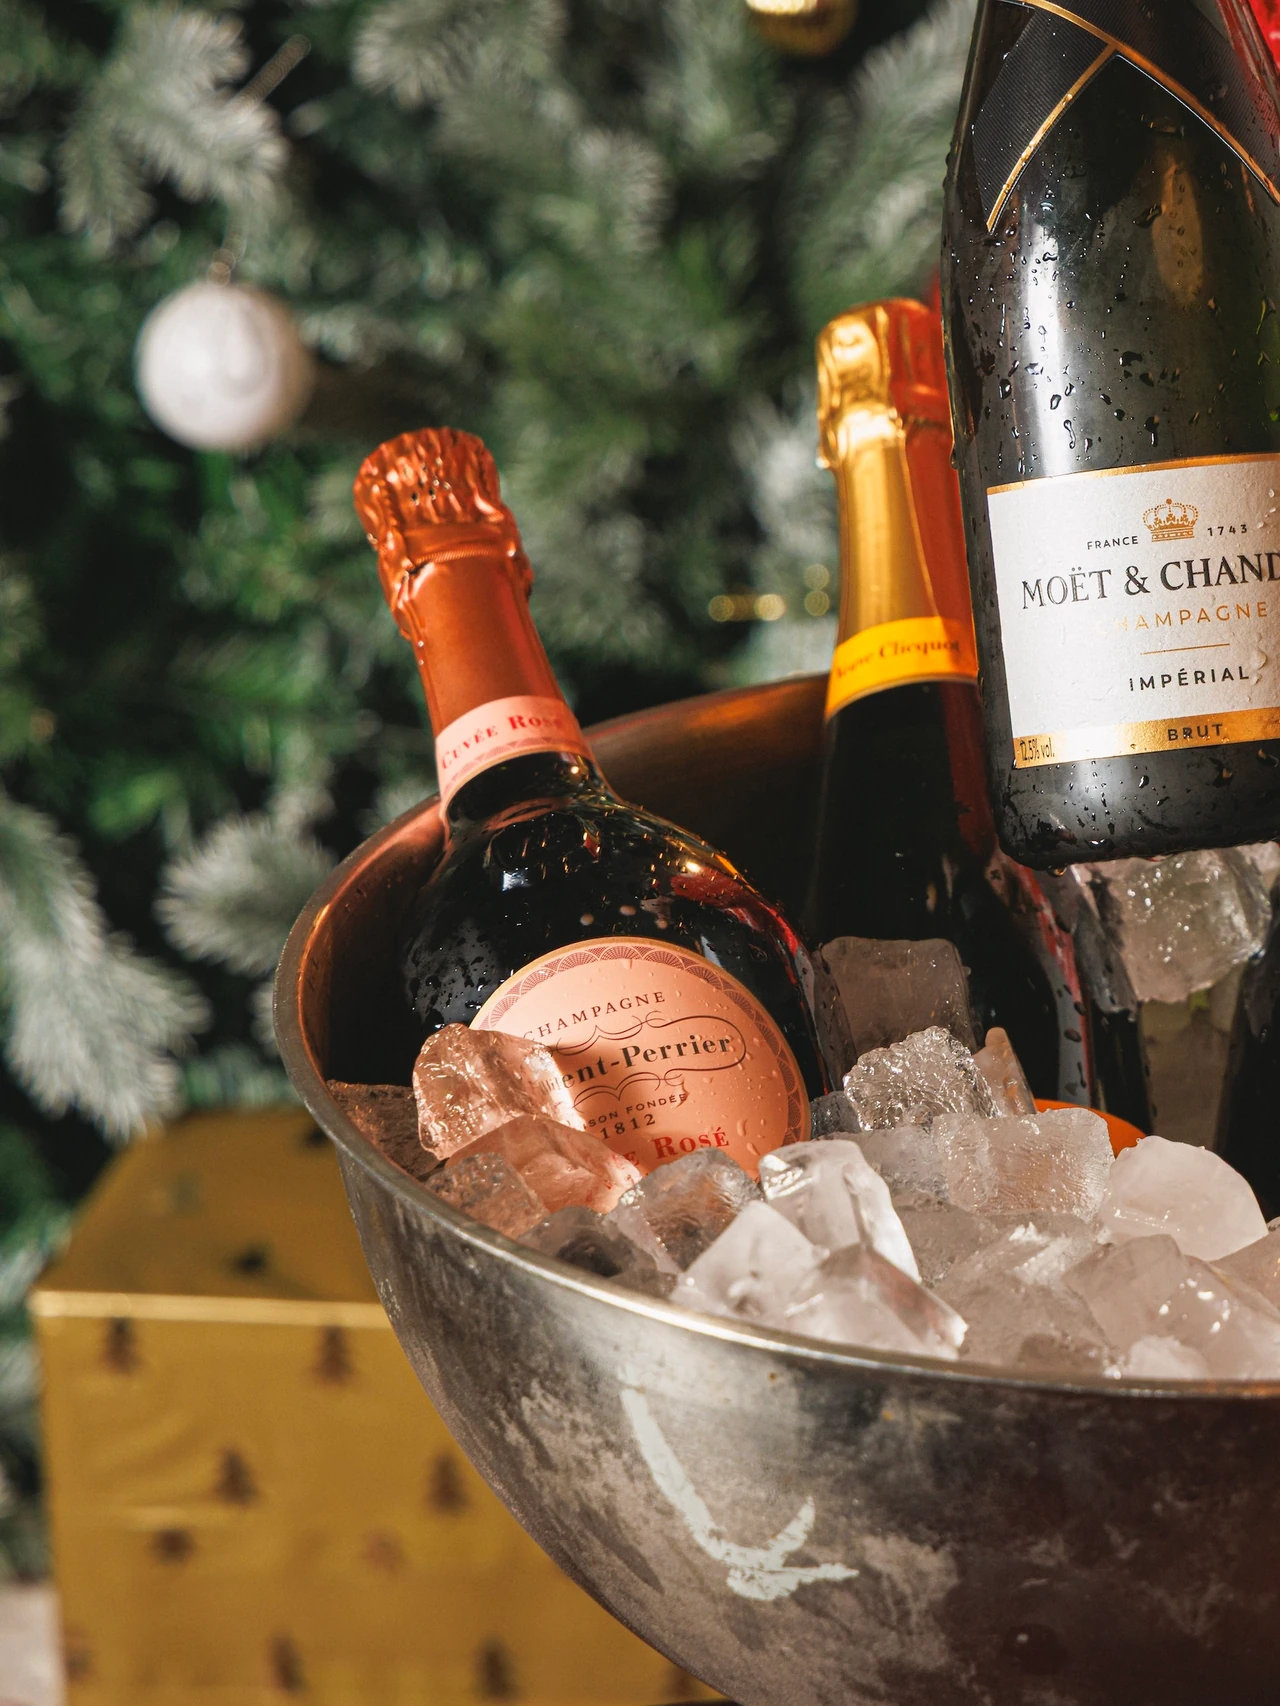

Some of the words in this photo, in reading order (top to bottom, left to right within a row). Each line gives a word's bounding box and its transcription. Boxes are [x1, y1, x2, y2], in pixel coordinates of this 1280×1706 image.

[1087, 535, 1139, 550] FRANCE
[1207, 523, 1249, 537] 1743
[1021, 566, 1113, 610] MOËT
[1123, 565, 1150, 596] &
[1095, 601, 1268, 635] CHAMPAGNE
[1129, 665, 1251, 692] IMPÉRIAL
[1167, 723, 1223, 742] BRUT
[523, 991, 665, 1041] CHAMPAGNE
[547, 1034, 733, 1091] ent-Perrier
[625, 1093, 688, 1114] FONDÉE
[600, 1112, 656, 1141] 1812
